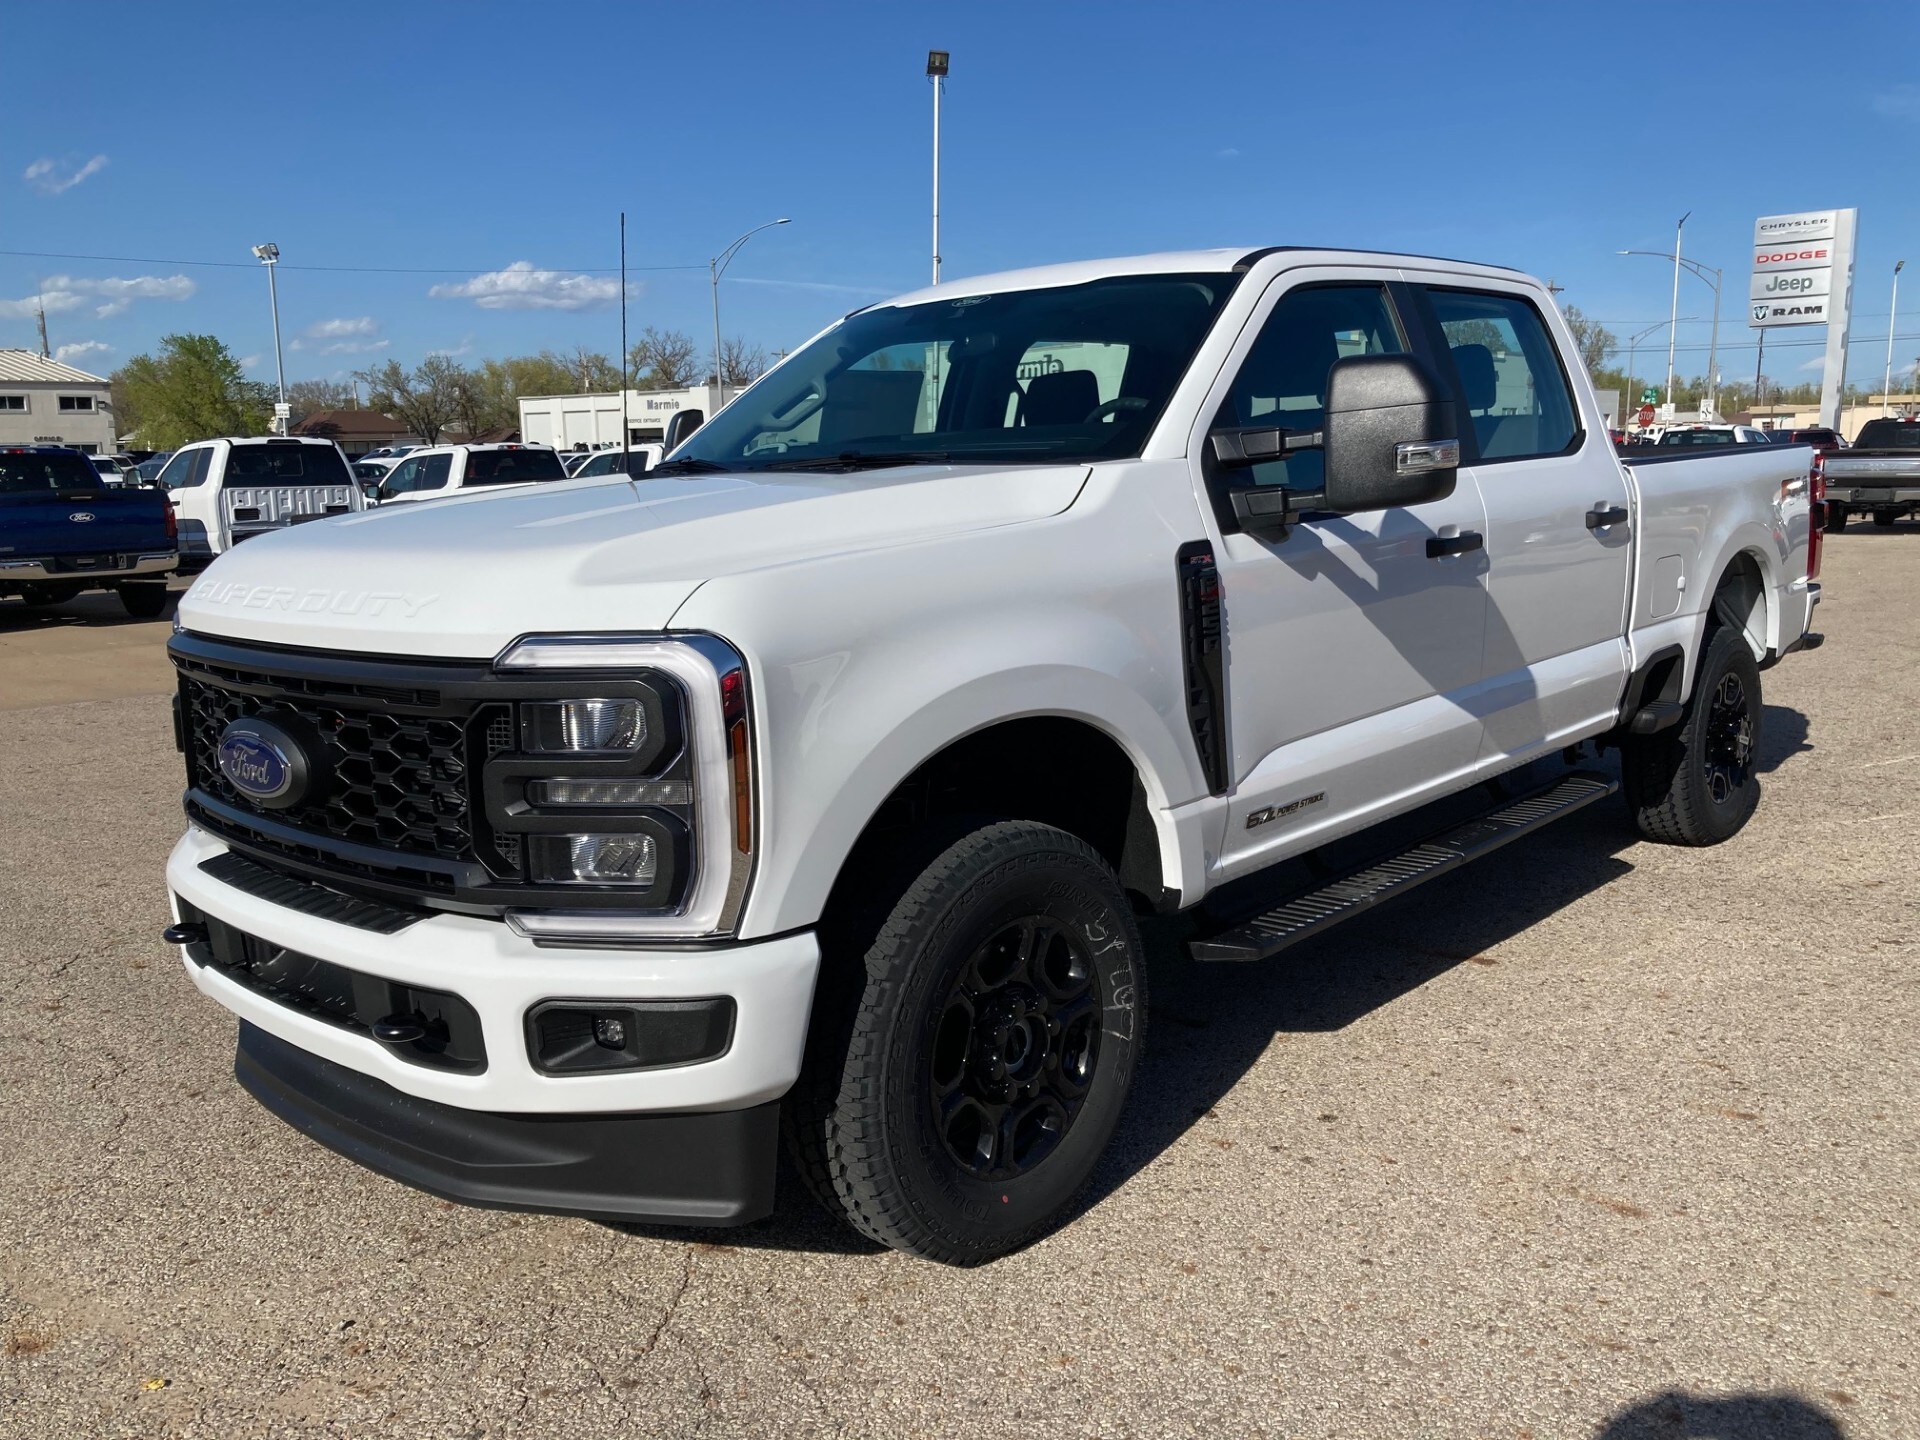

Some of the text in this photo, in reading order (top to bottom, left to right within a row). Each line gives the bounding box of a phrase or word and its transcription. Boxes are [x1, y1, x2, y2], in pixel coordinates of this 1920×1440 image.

[1760, 218, 1829, 231] CHRYSLER
[1756, 250, 1828, 264] DODGE
[1765, 275, 1813, 292] Jeep
[1772, 305, 1823, 316] RAM
[646, 399, 680, 410] Marmie
[1640, 411, 1654, 421] STOP
[191, 579, 441, 618] SUPER DUTY
[231, 744, 270, 785] Ford
[1277, 801, 1299, 815] POWER
[1300, 791, 1325, 808] STROKE
